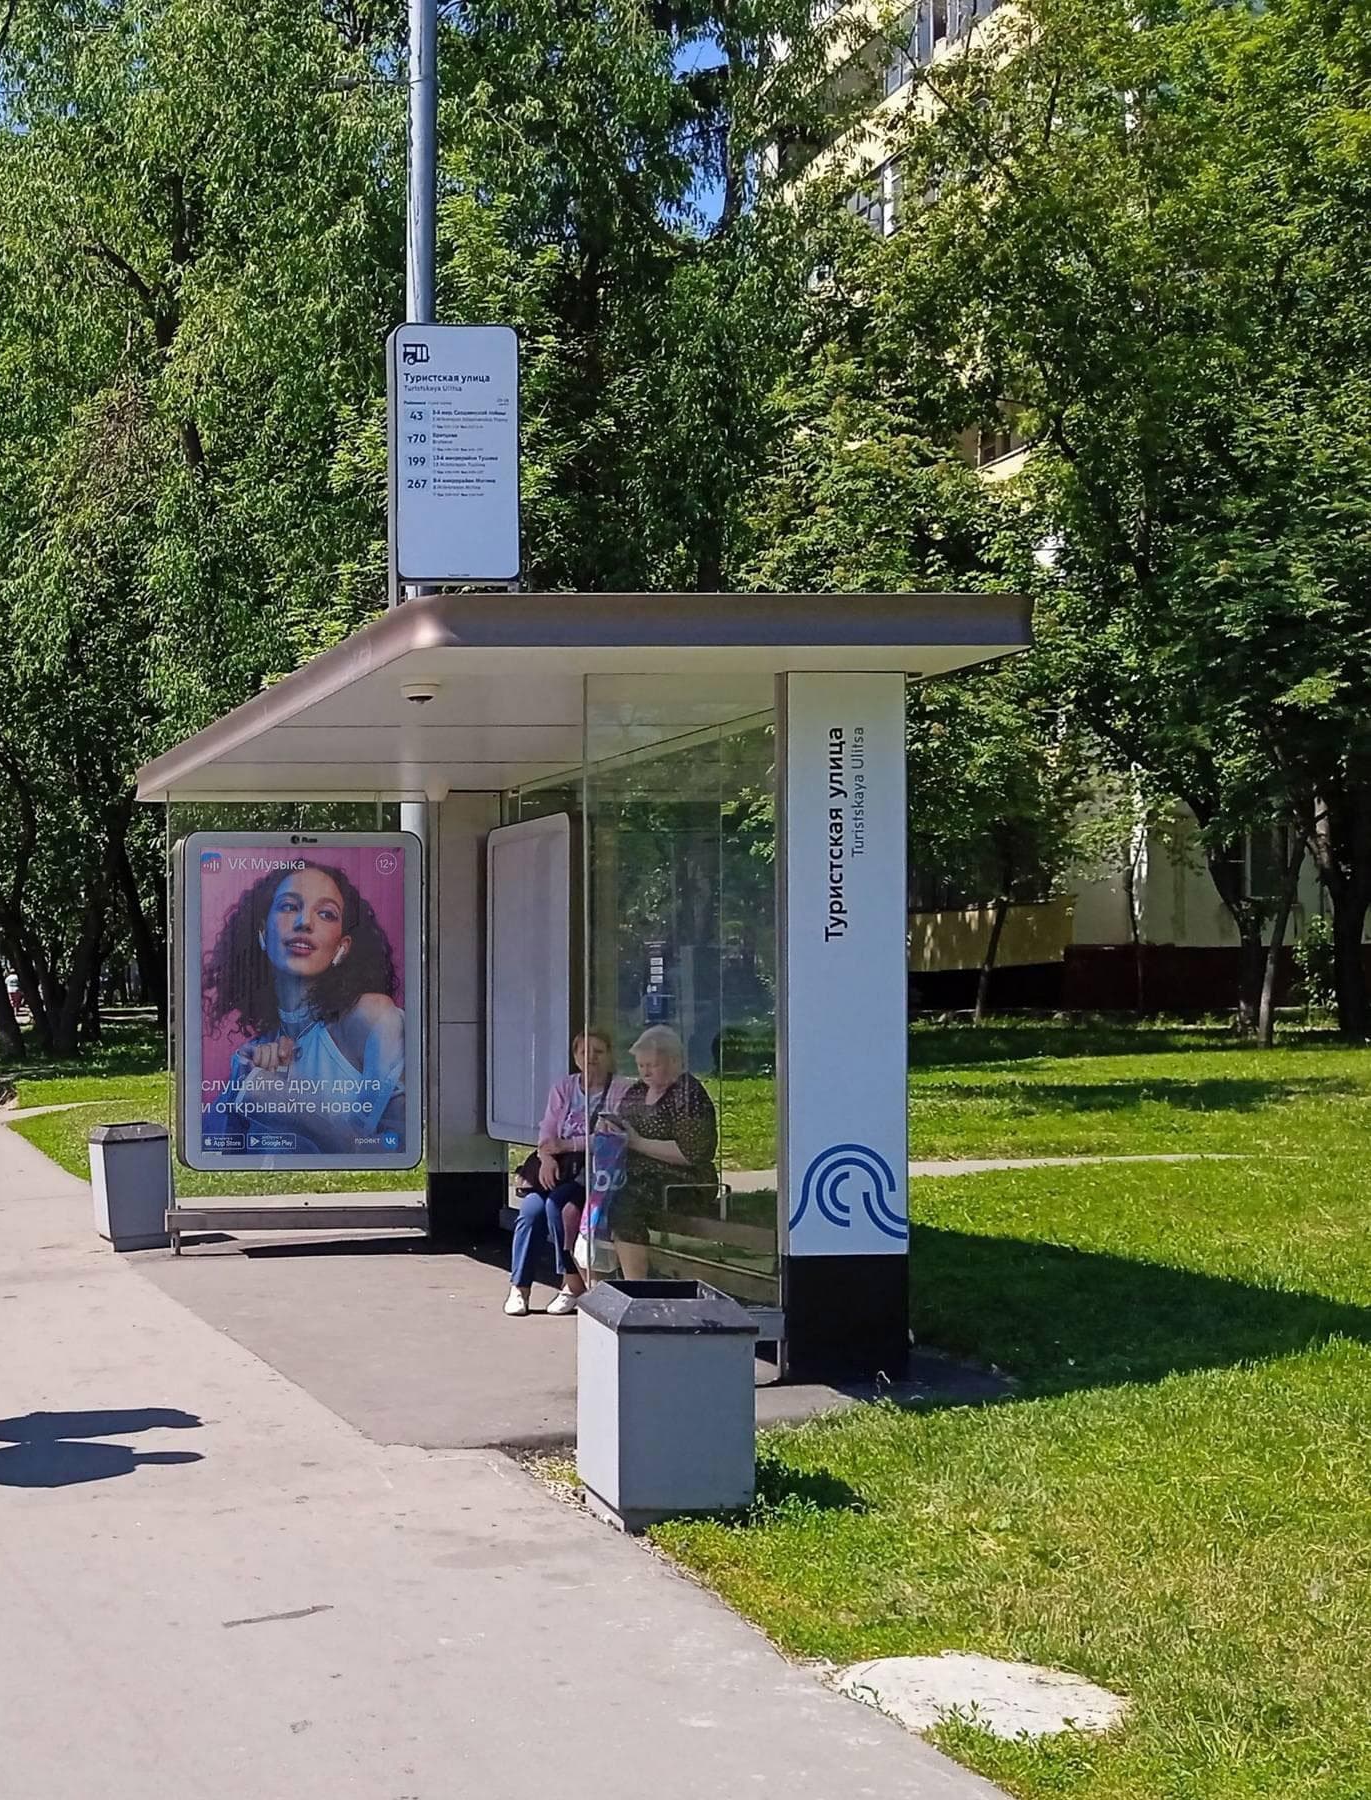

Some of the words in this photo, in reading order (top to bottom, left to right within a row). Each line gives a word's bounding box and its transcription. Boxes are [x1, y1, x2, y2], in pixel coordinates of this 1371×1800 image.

[404, 373, 459, 384] Туристская
[461, 375, 490, 383] улица
[410, 411, 423, 420] 43
[407, 434, 426, 443] т70
[407, 457, 426, 466] 199
[407, 480, 427, 488] 267
[850, 727, 865, 769] Ulitsa
[828, 727, 848, 799] улица
[851, 775, 867, 857] Turistskaya
[228, 858, 247, 870] VK
[251, 858, 306, 873] Музыка
[379, 859, 395, 869] 12+
[825, 807, 848, 942] Туристская
[201, 1077, 285, 1095] слушайте
[289, 1080, 329, 1095] друг
[332, 1080, 381, 1095] друга
[201, 1102, 211, 1113] и
[215, 1099, 317, 1116] открывайте
[321, 1102, 373, 1113] новое
